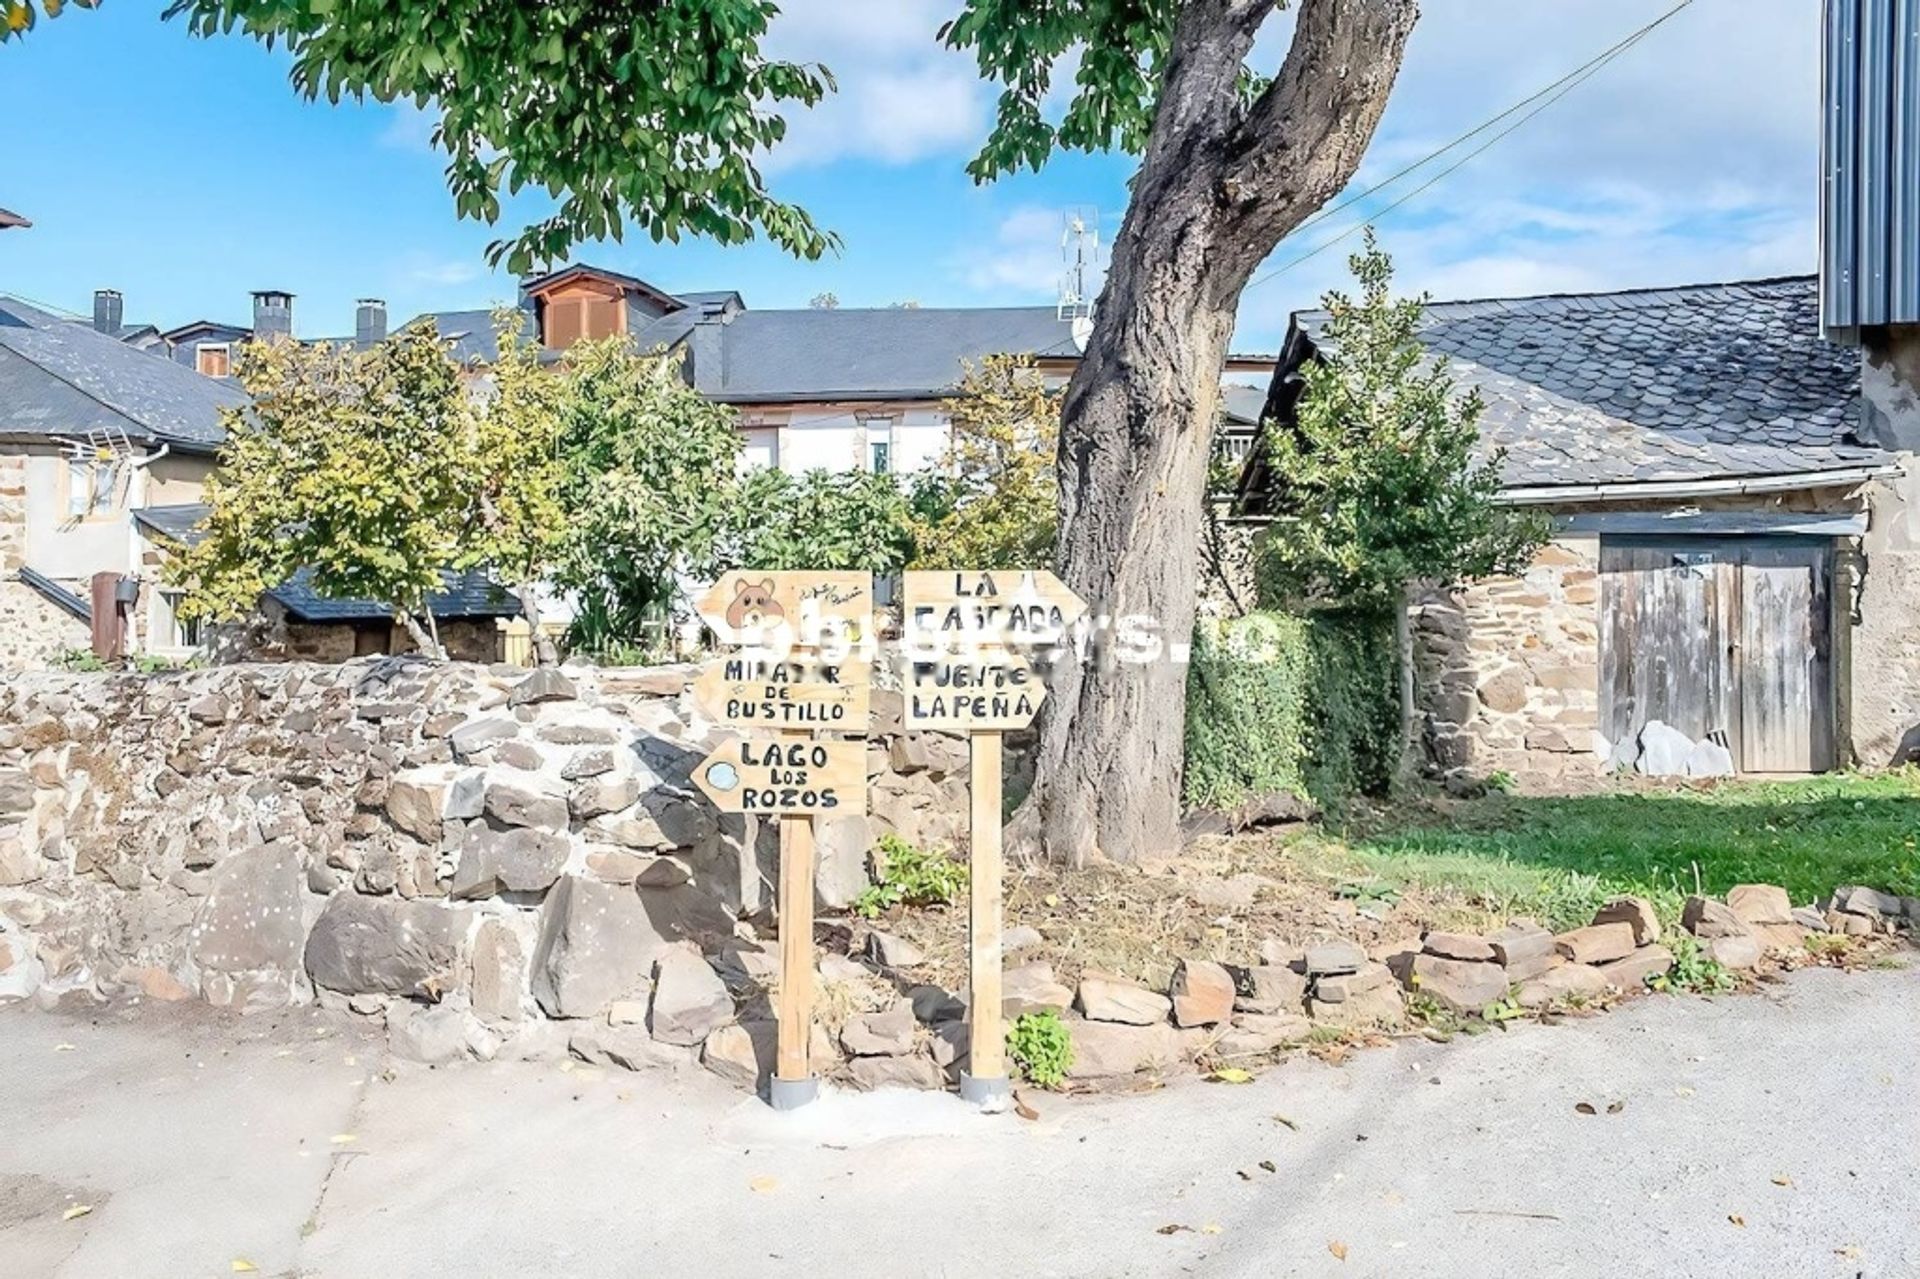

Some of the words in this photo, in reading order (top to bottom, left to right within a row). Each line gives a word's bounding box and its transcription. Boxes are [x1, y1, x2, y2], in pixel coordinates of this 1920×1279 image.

[956, 573, 998, 597] LA
[724, 660, 839, 683] MIAR
[765, 686, 789, 699] DE
[727, 699, 843, 721] BUSTILLO
[741, 743, 827, 768] LAGO
[771, 768, 807, 785] LOS
[742, 788, 838, 809] ROZOS
